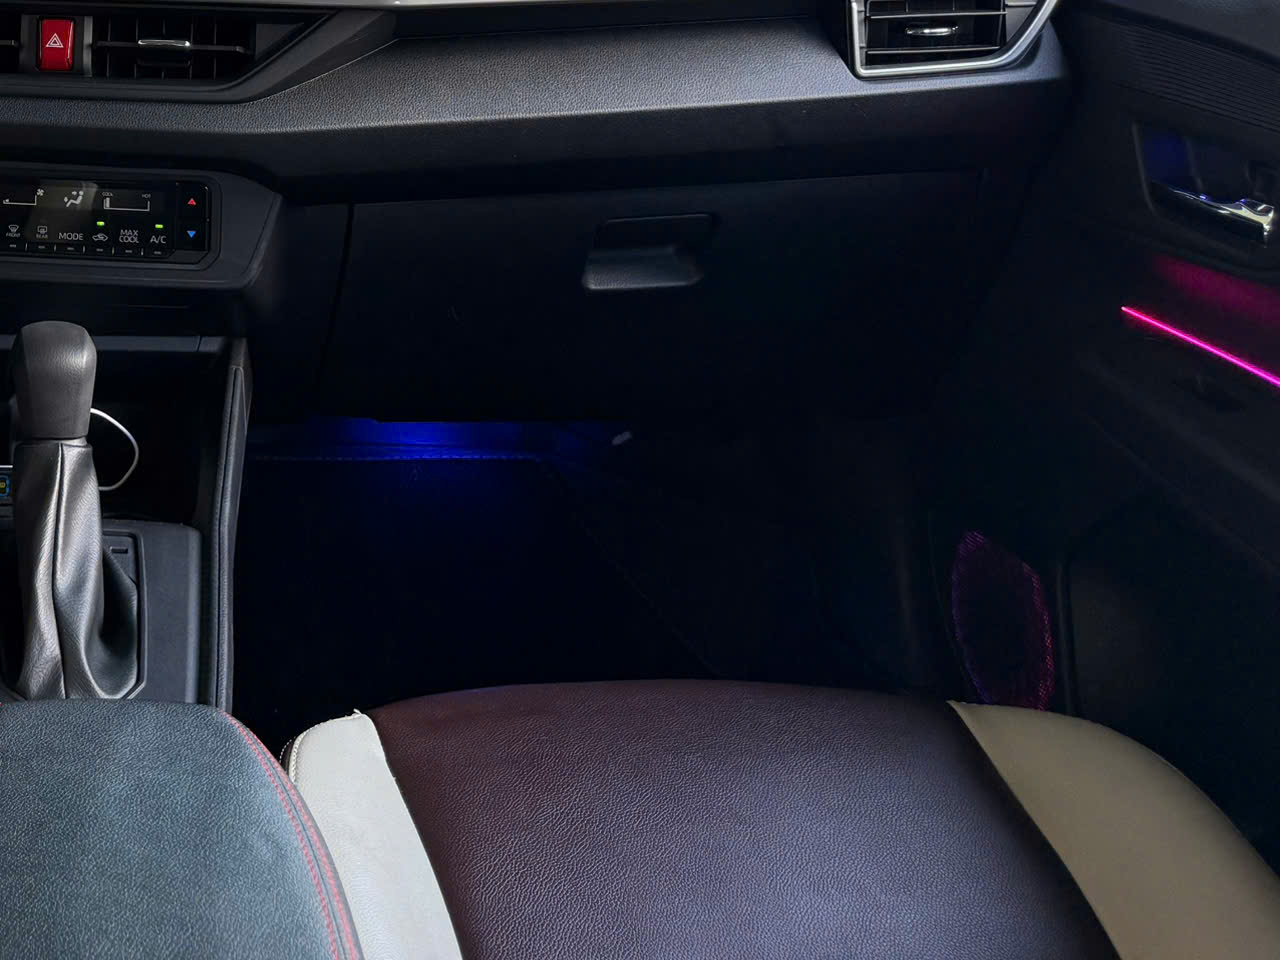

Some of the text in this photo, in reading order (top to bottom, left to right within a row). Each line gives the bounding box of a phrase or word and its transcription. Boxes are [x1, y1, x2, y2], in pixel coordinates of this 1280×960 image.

[58, 232, 84, 241] MODE
[119, 236, 140, 244] COOL
[150, 235, 167, 244] A/C
